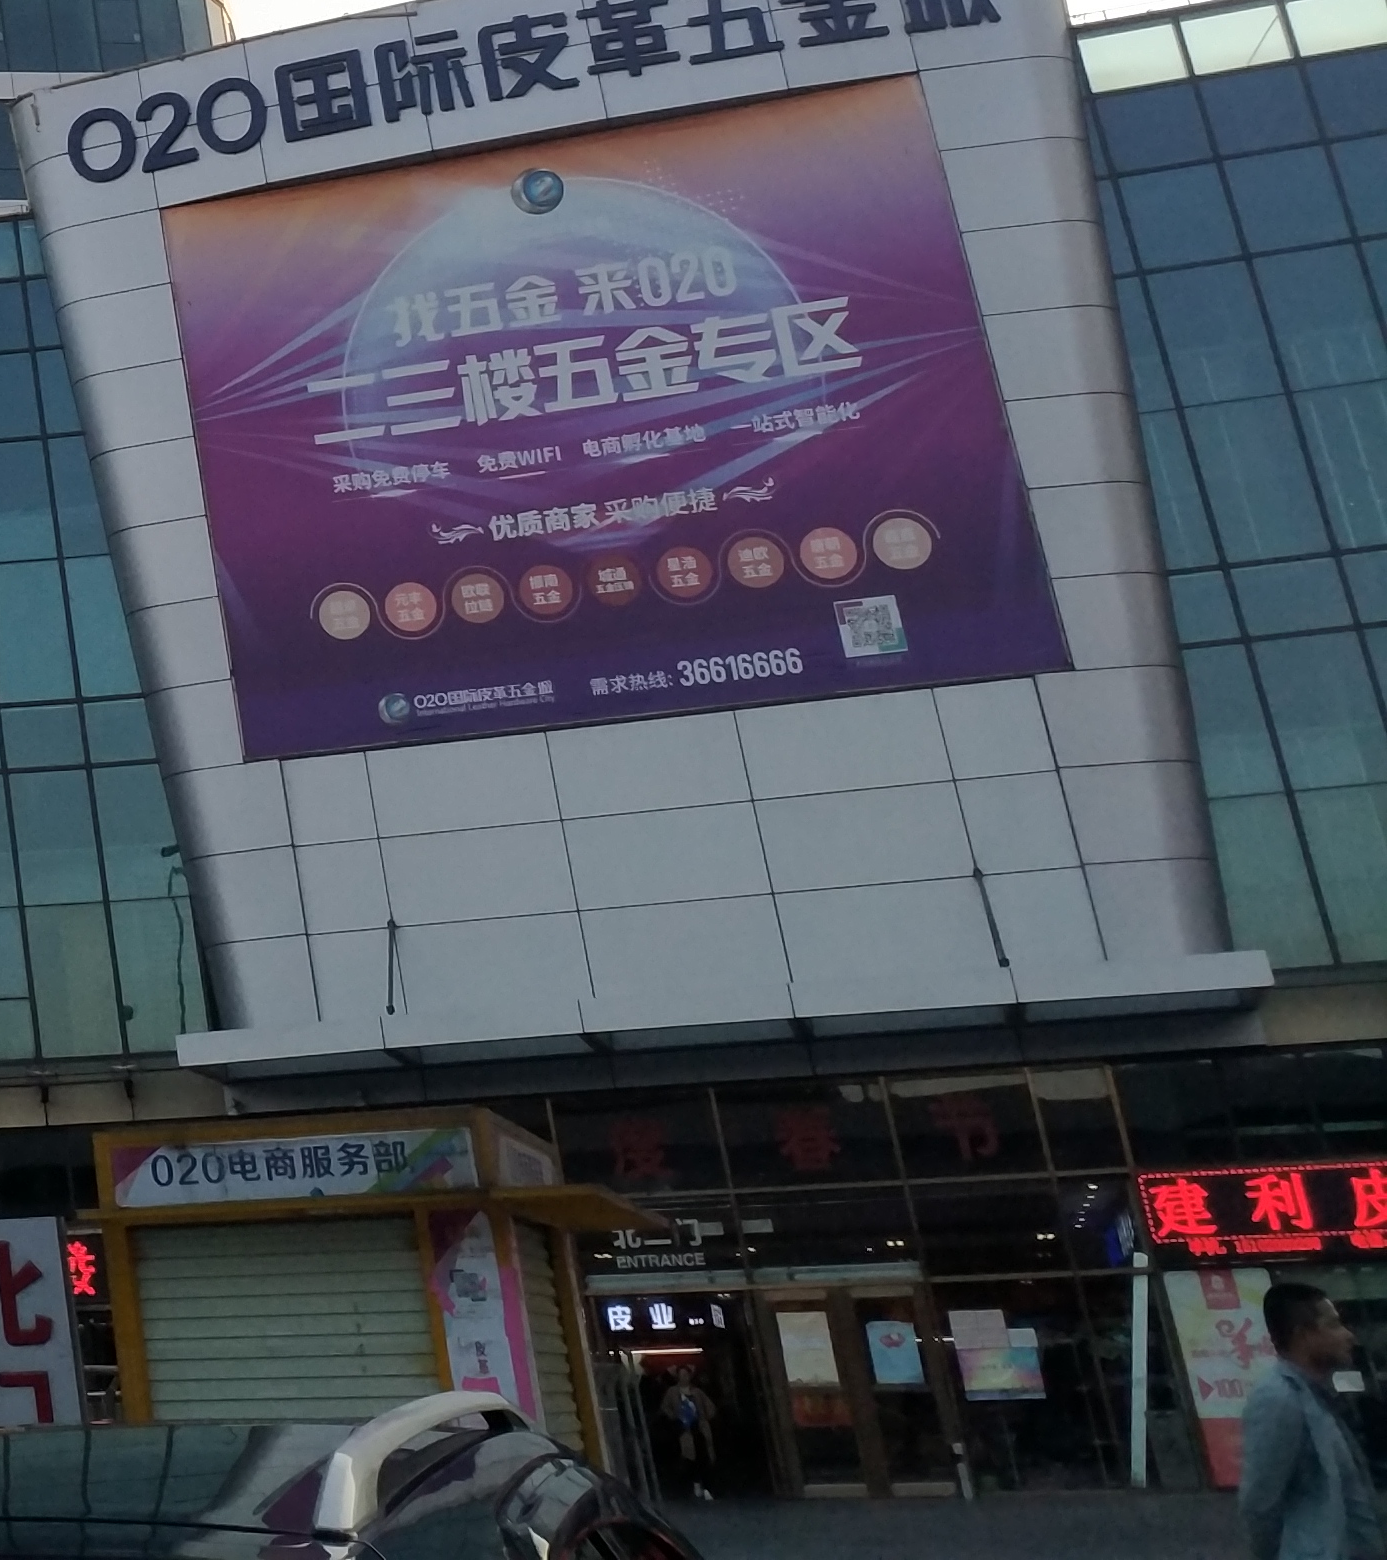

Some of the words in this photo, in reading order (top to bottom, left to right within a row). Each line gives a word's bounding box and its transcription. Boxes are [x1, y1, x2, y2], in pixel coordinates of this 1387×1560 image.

[386, 273, 562, 348] 找五金
[306, 295, 864, 446] 二三楼五金专区
[488, 502, 601, 542] 优质商家
[603, 487, 719, 526] 采购便捷
[676, 647, 804, 687] 36616666
[615, 1252, 707, 1270] ENTRANCE
